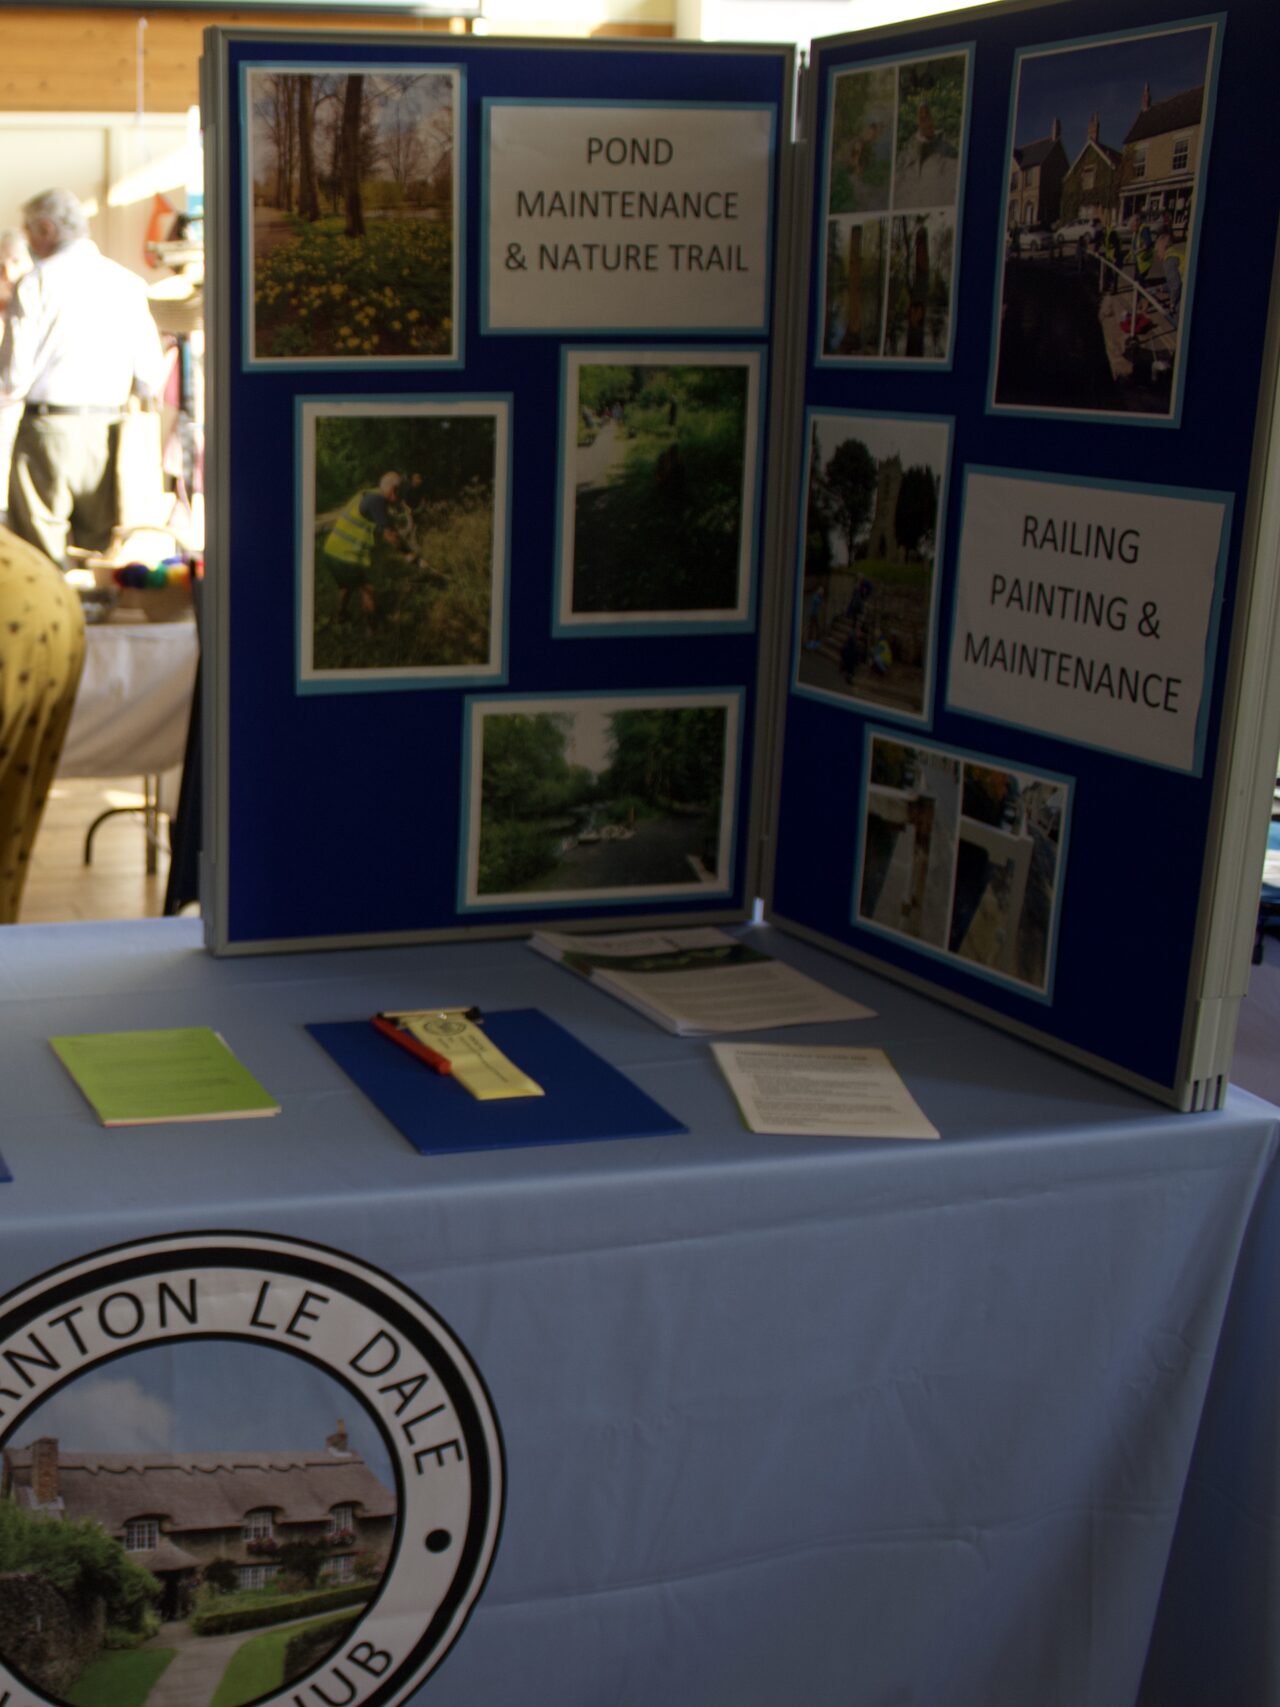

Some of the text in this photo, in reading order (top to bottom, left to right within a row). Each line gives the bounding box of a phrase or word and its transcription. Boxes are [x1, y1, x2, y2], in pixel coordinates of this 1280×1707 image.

[587, 137, 674, 167] POND
[517, 190, 740, 222] MAINTENANCE
[504, 242, 750, 273] & NATURE TRAIL
[1022, 515, 1141, 565] RAILING
[991, 572, 1161, 640] PAINTING &
[964, 631, 1182, 715] MAINTENANCE
[248, 1280, 331, 1341] LE
[348, 1329, 465, 1476] DALE
[292, 1640, 395, 1707] UB
